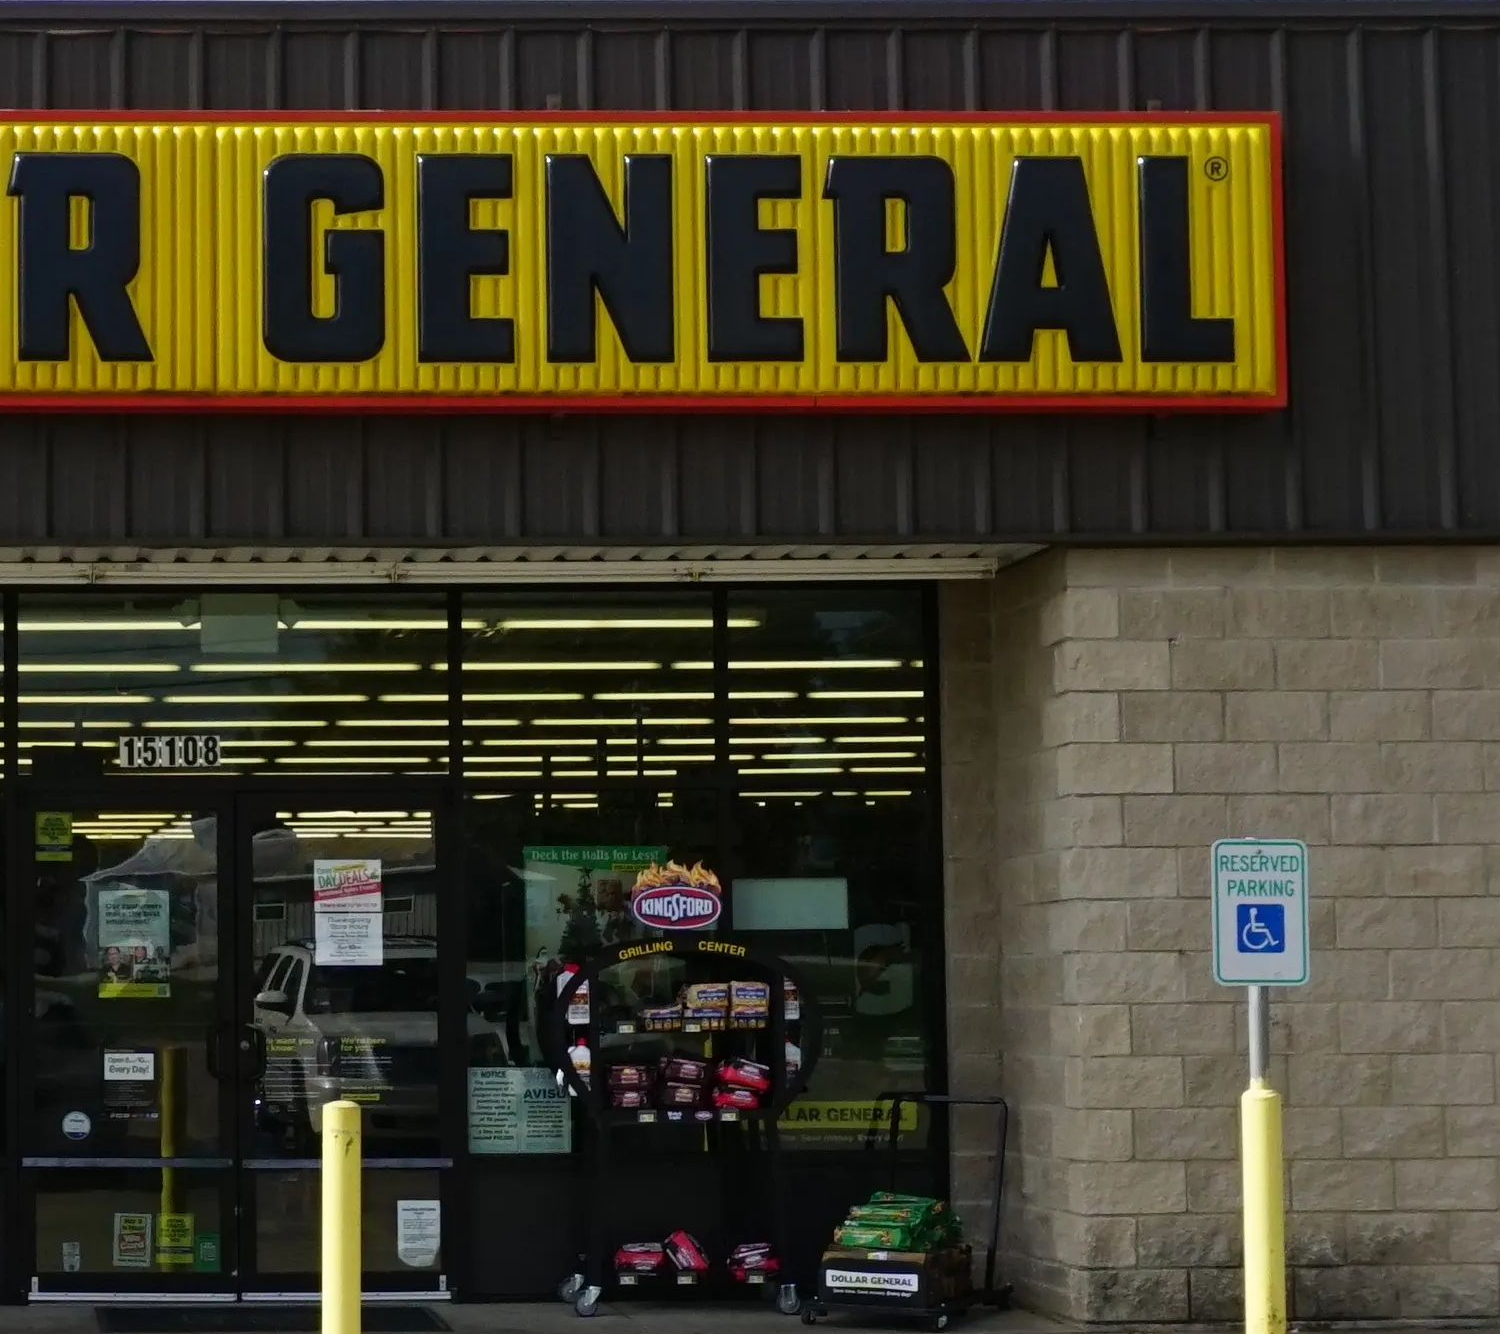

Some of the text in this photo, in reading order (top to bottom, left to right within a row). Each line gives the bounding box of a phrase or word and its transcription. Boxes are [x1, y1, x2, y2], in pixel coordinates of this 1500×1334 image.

[124, 736, 218, 766] 15108
[531, 849, 659, 861] Deck the Halls for Less!
[1220, 855, 1299, 872] RESERVED
[1227, 879, 1295, 897] PARKING
[641, 893, 713, 922] KINGSFORD
[618, 940, 746, 960] GRILLING CENTER
[481, 1070, 506, 1078] NOTICE
[831, 1274, 913, 1287] DOLLAR GENERAL
